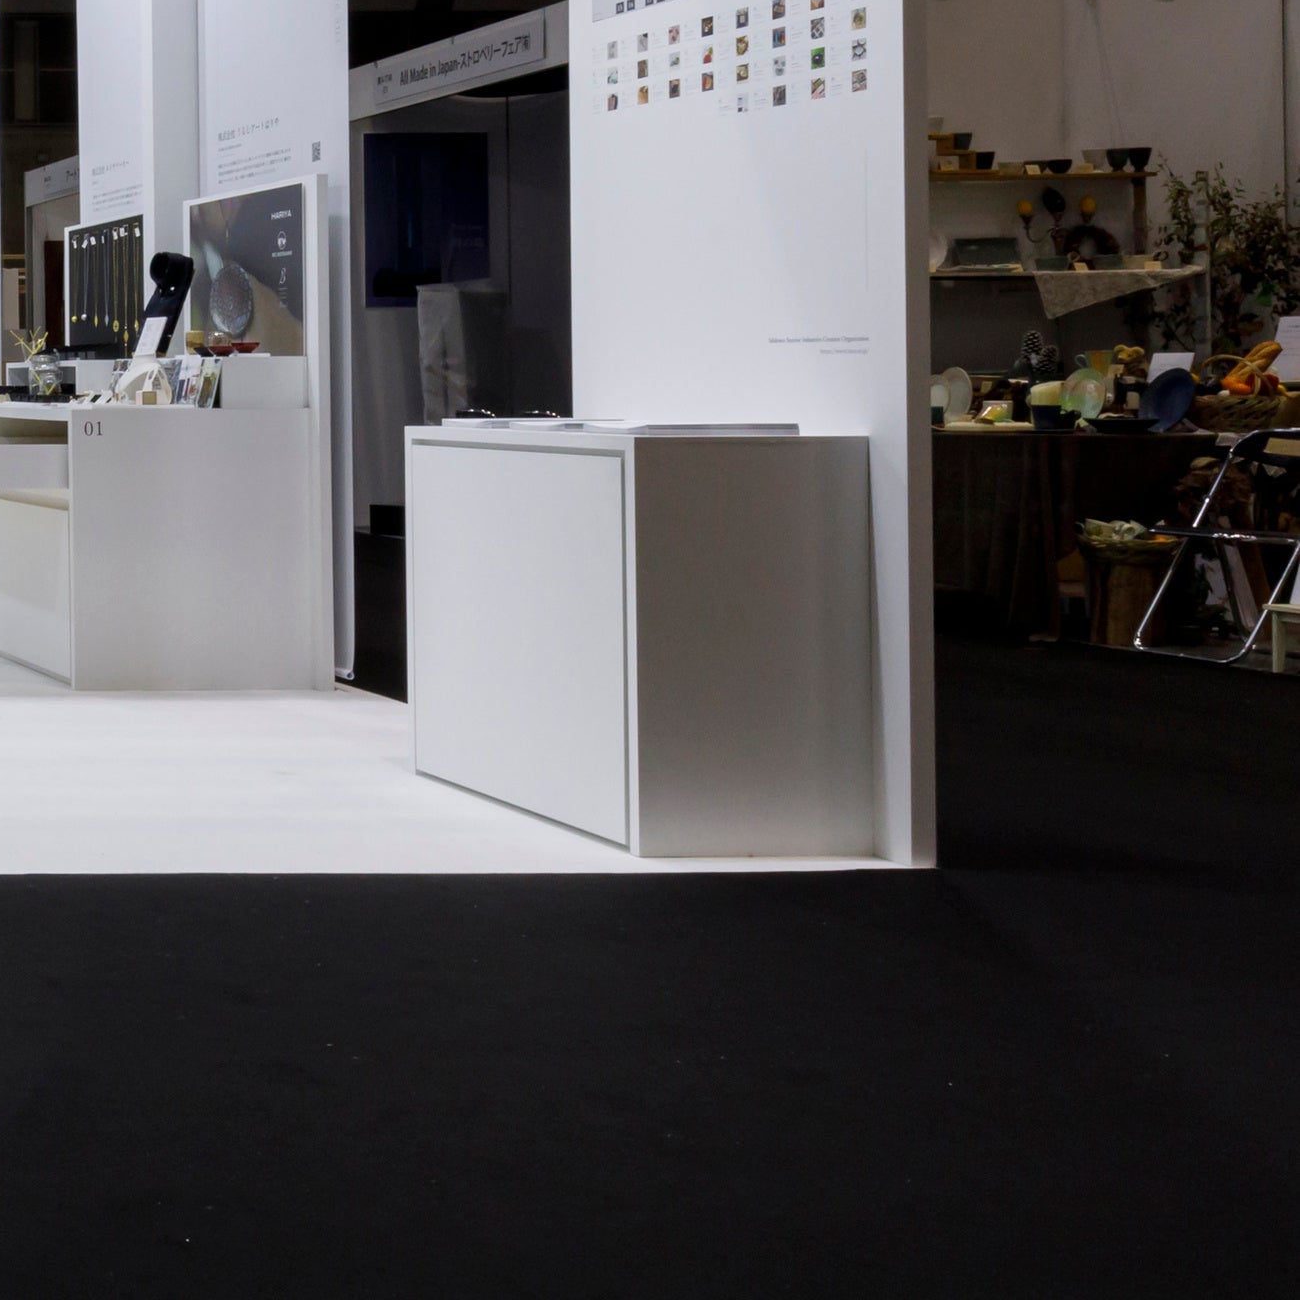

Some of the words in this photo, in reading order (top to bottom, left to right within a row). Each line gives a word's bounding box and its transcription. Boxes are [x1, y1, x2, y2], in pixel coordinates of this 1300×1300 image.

[400, 68, 409, 86] All
[410, 63, 428, 82] Made
[429, 63, 437, 77] in
[270, 209, 292, 221] HARIYA
[84, 421, 103, 437] 01
